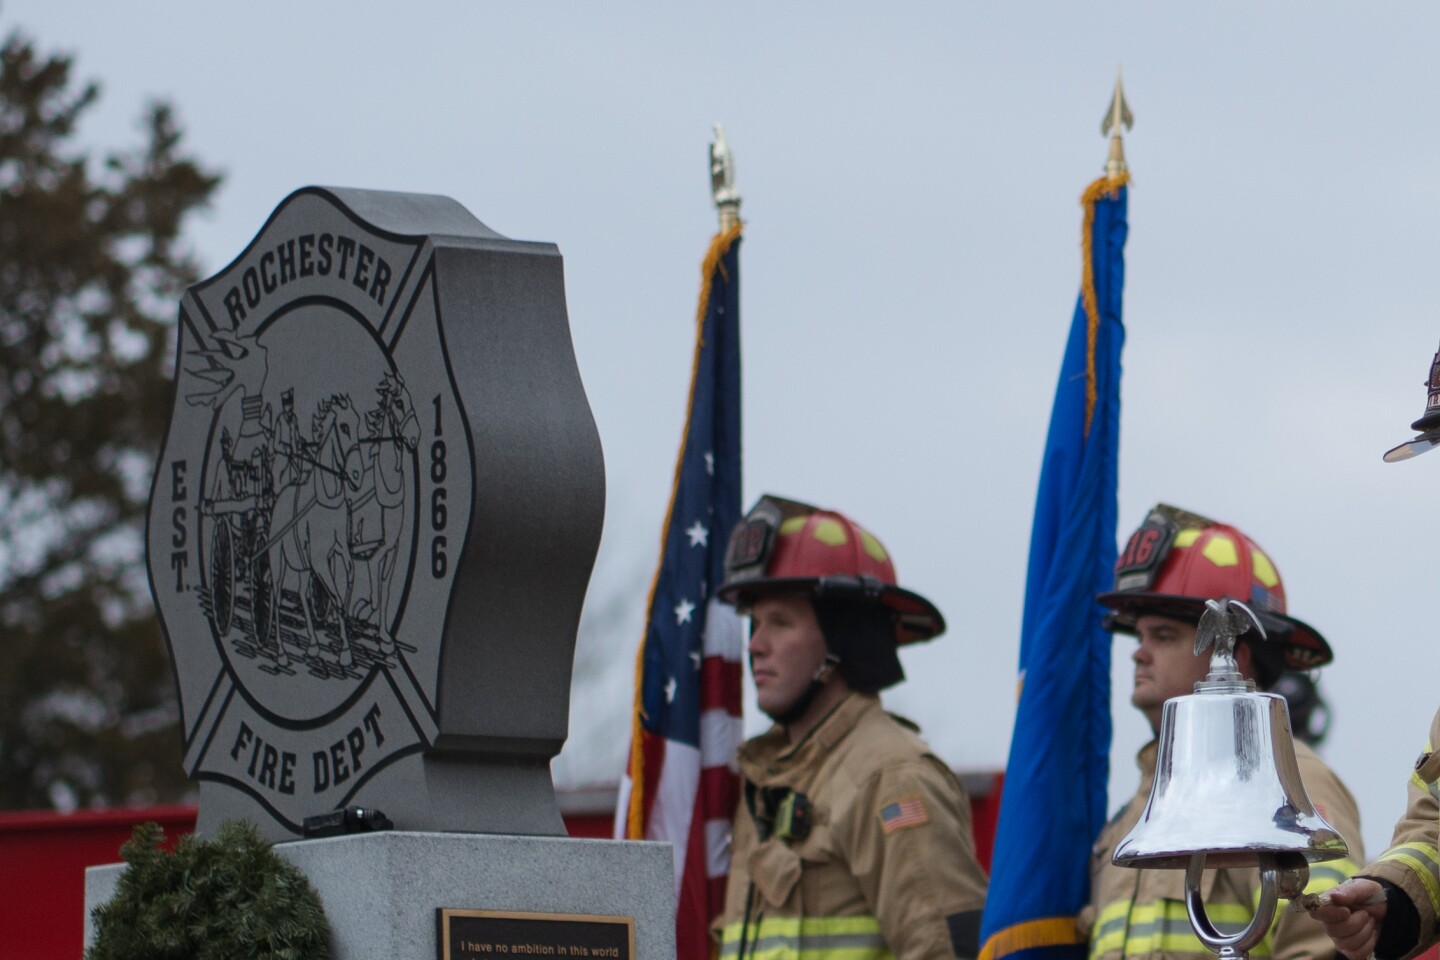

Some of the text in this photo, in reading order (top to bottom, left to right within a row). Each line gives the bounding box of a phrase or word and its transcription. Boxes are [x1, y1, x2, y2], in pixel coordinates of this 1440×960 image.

[222, 234, 393, 330] ROCHESTER
[429, 395, 449, 582] 1866
[231, 701, 386, 795] FIRE DEPT
[468, 941, 493, 952] have
[495, 944, 509, 953] no
[511, 943, 555, 954] ambition
[557, 944, 567, 954] in
[569, 945, 589, 956] this
[591, 946, 619, 957] world
